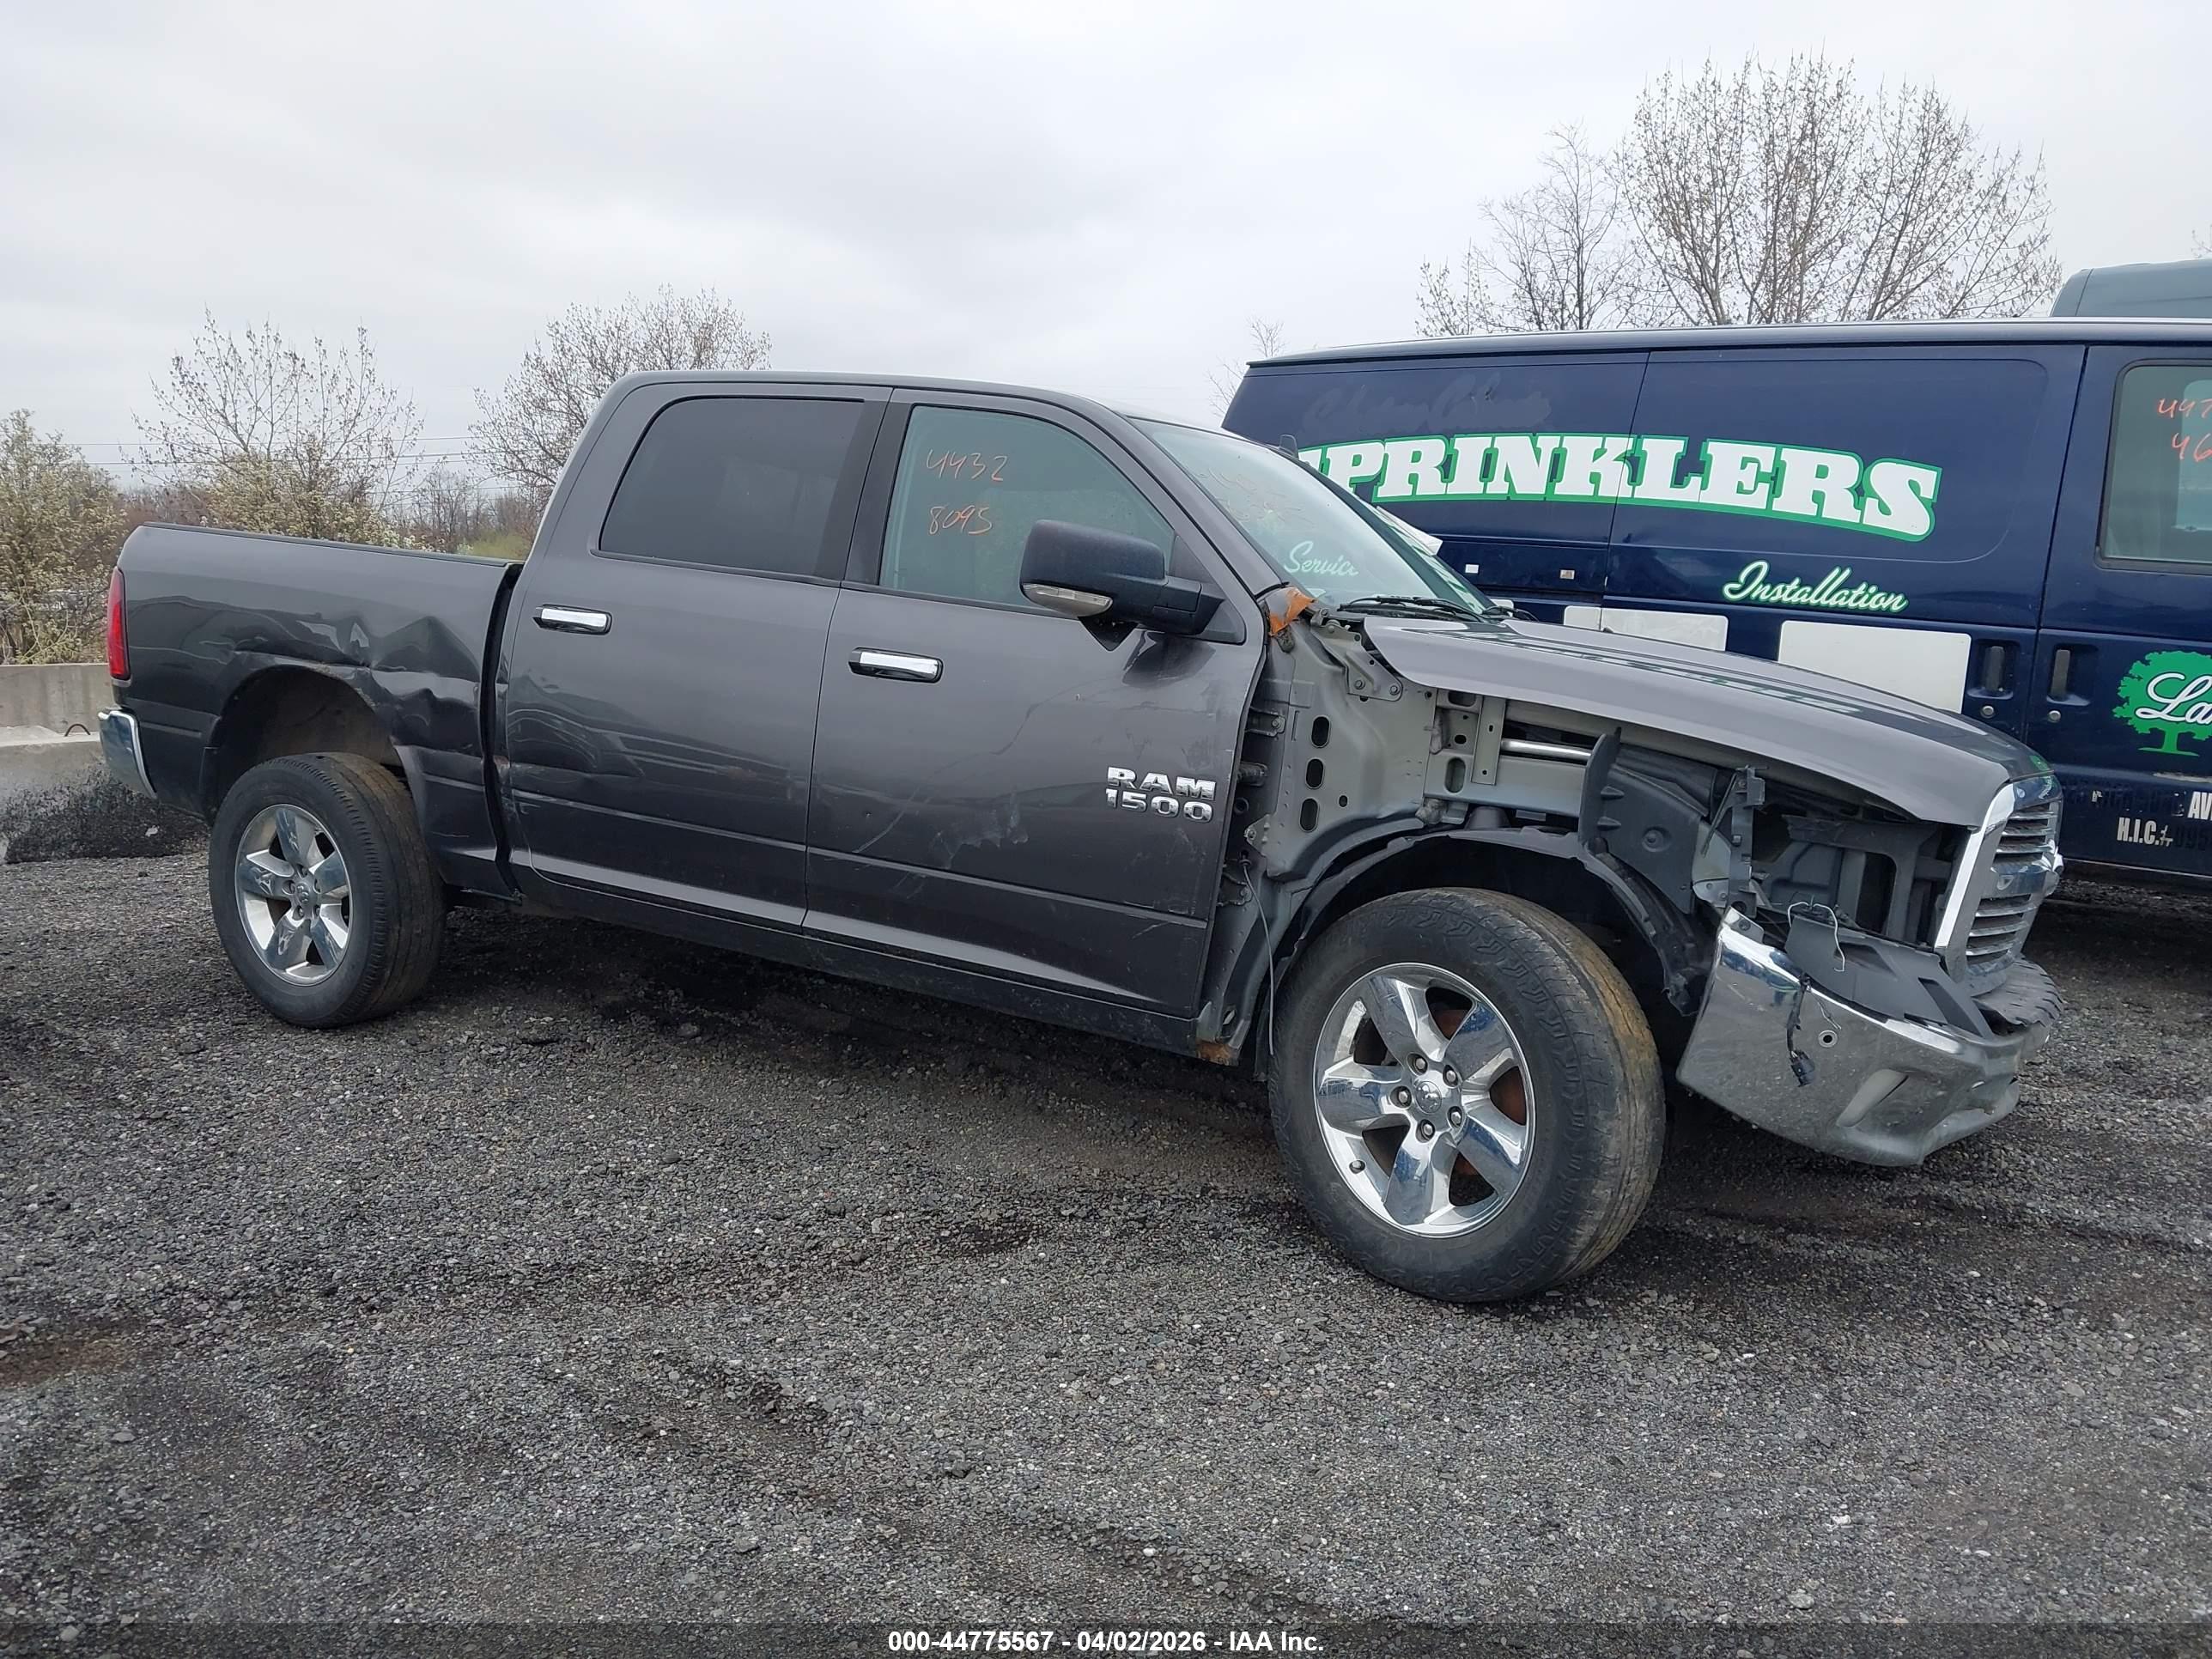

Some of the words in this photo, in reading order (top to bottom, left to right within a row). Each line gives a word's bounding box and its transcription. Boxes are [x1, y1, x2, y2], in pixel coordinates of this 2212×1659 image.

[926, 448, 1008, 482] 4432
[928, 504, 994, 536] 8095
[1723, 559, 1909, 613] Installation
[1107, 766, 1217, 801] RAM
[1104, 788, 1213, 823] 1500
